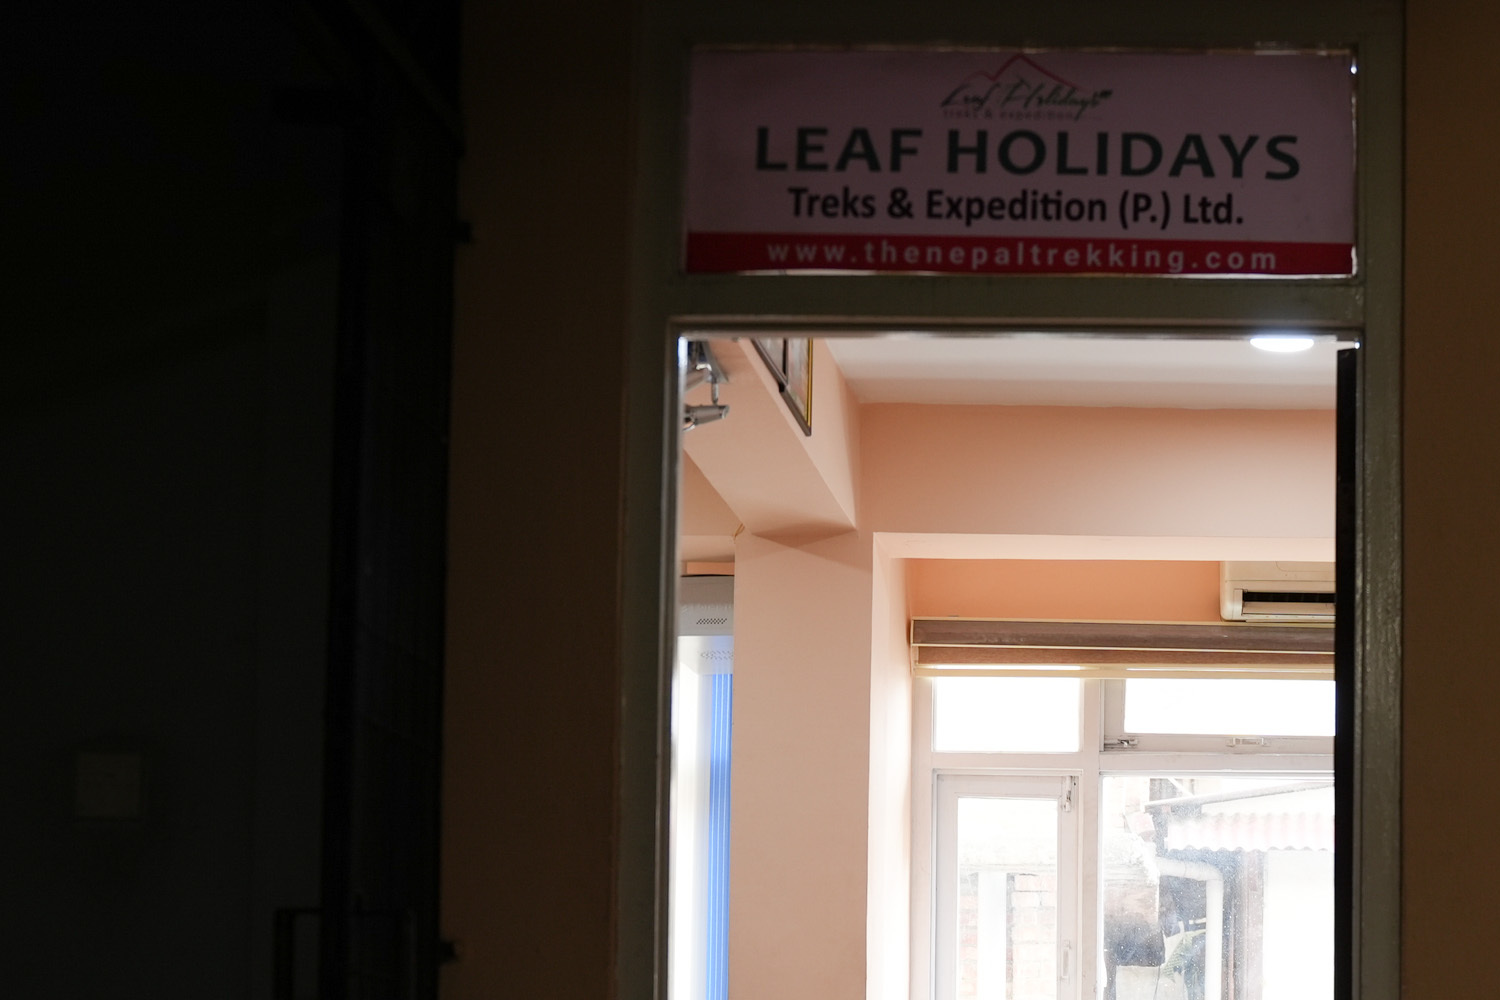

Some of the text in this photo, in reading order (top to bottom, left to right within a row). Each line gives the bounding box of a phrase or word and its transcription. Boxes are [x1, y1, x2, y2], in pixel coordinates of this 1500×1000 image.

[756, 126, 1300, 181] LEAF HOLIDAYS
[787, 186, 1243, 230] Treks & Expedition (P.) Ltd.
[766, 238, 1277, 275] www.thenepaltrekking.com
